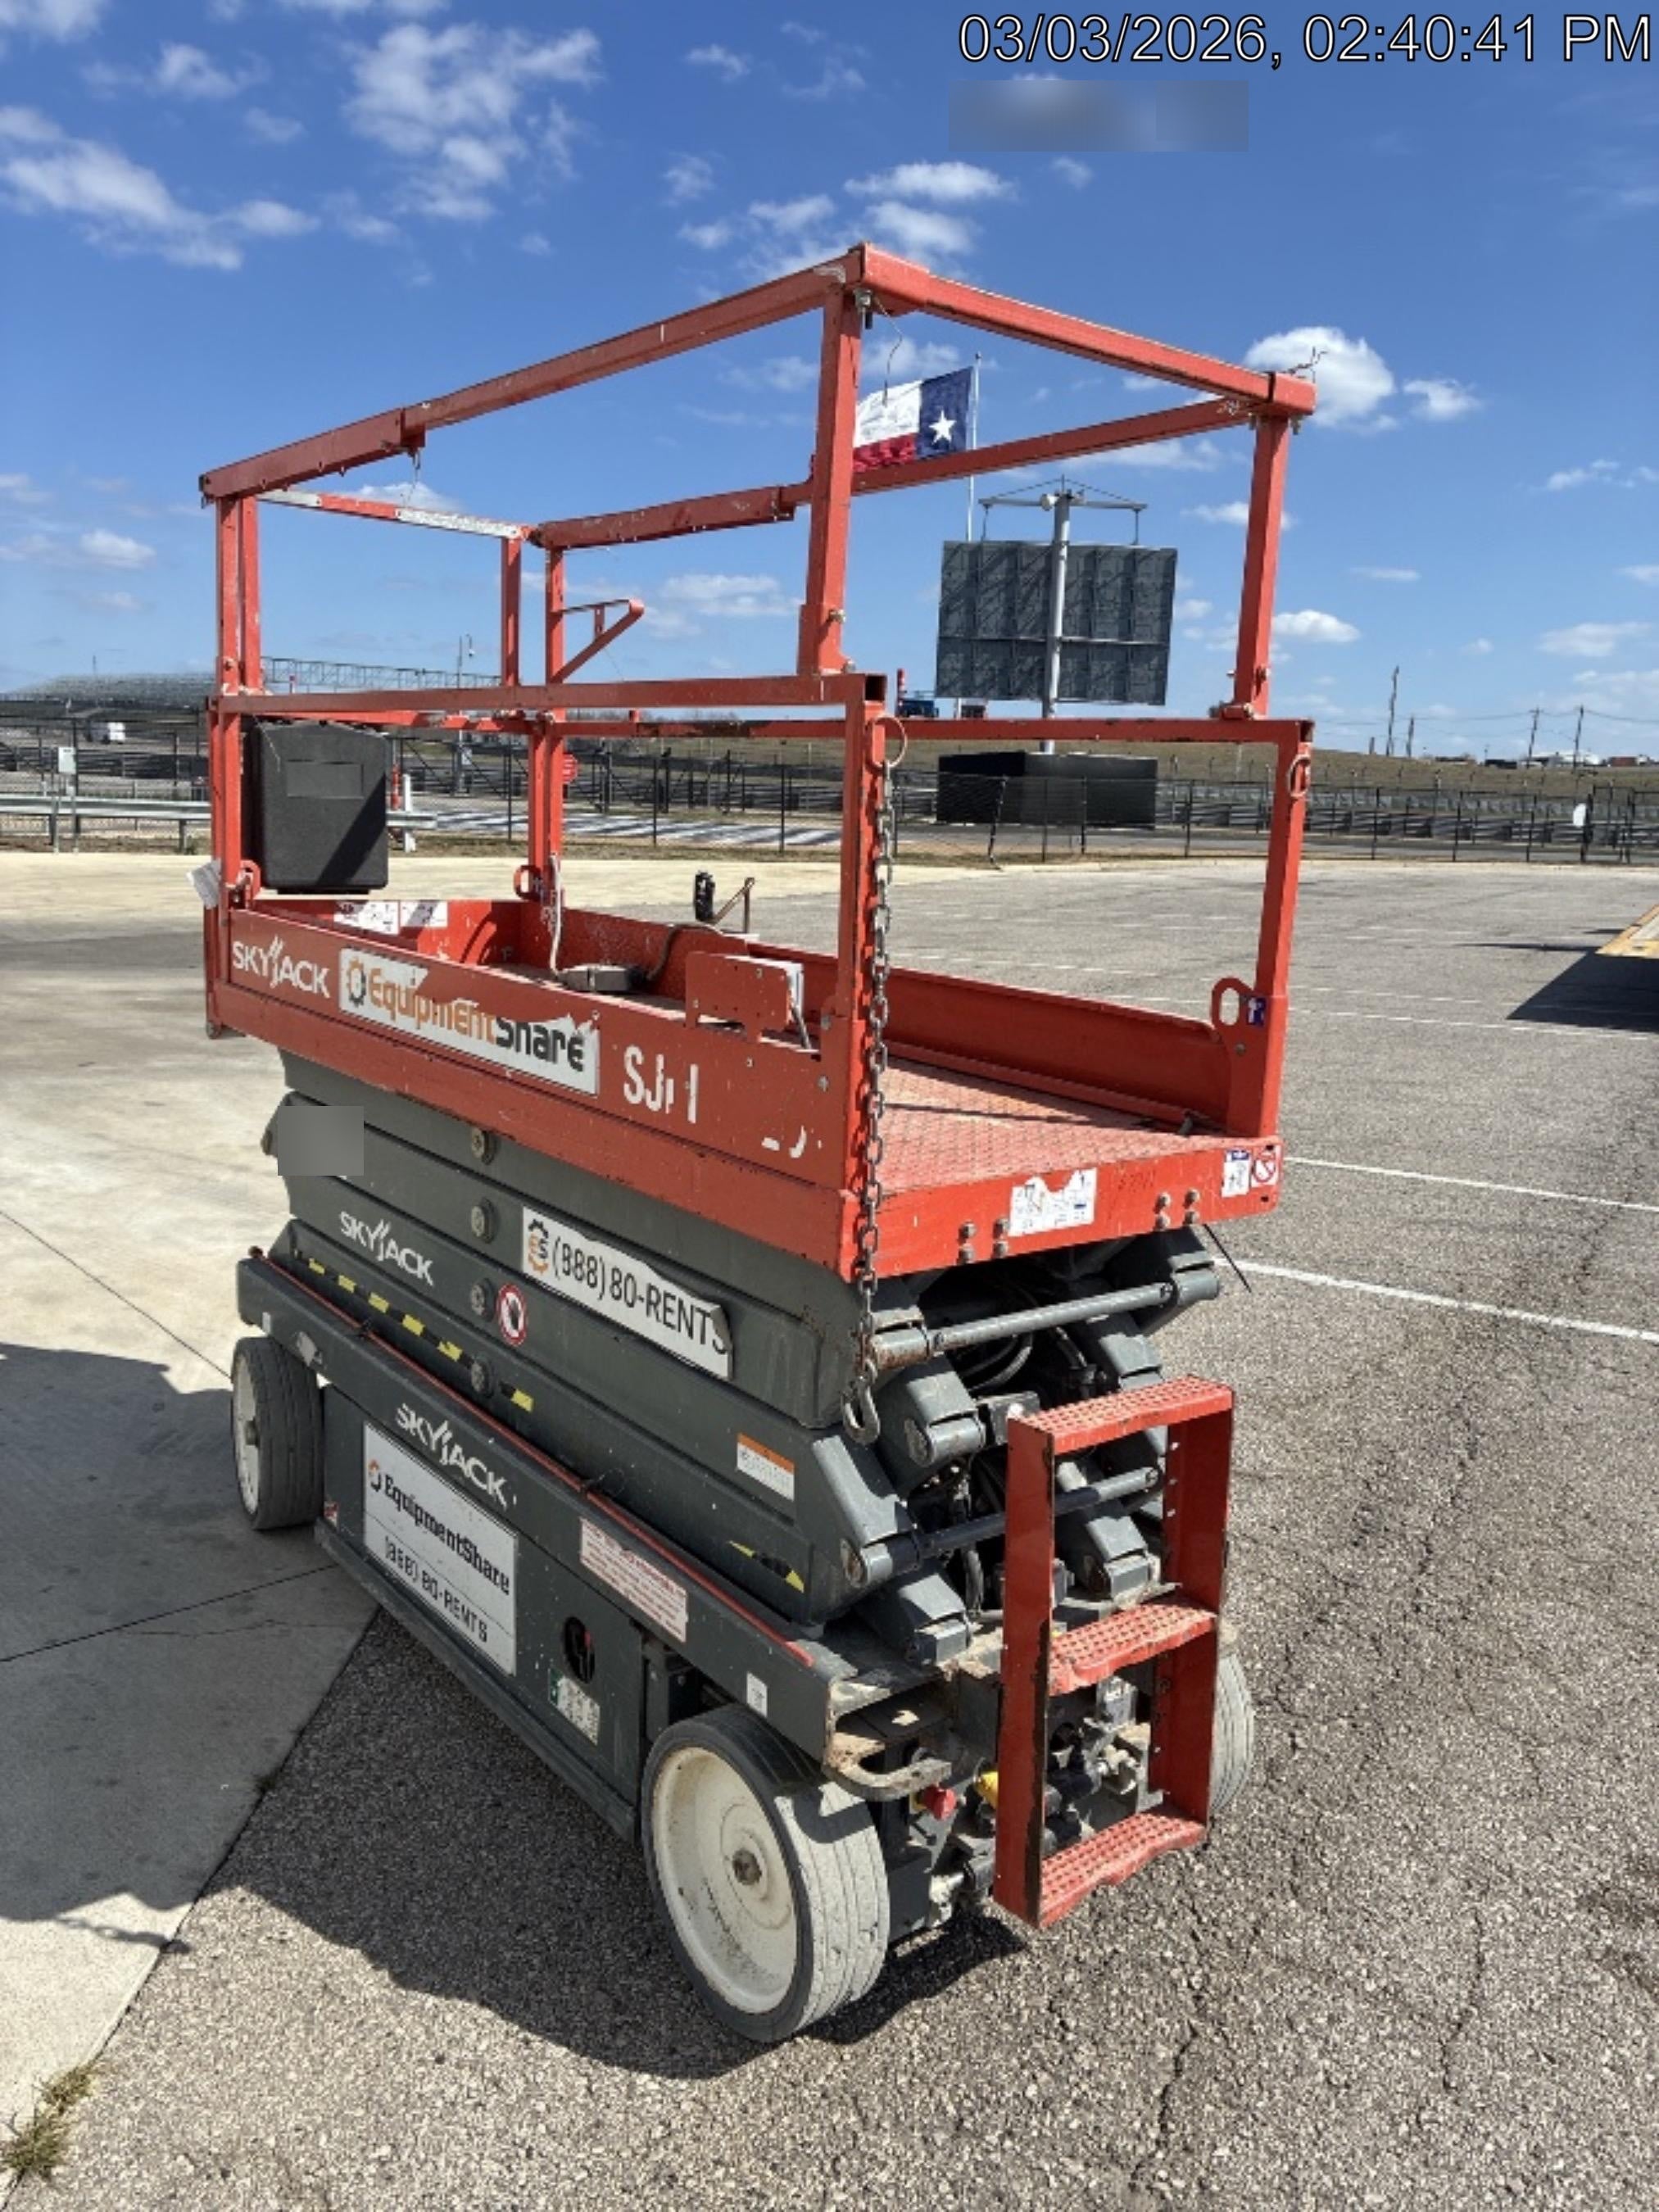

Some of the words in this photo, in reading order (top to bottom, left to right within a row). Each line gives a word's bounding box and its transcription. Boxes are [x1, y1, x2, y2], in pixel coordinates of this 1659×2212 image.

[232, 935, 330, 998] SKYJACK
[338, 1211, 434, 1286] SKYJACK
[395, 1403, 508, 1509] SKYJACK
[384, 1475, 510, 1596] EquipmentShare
